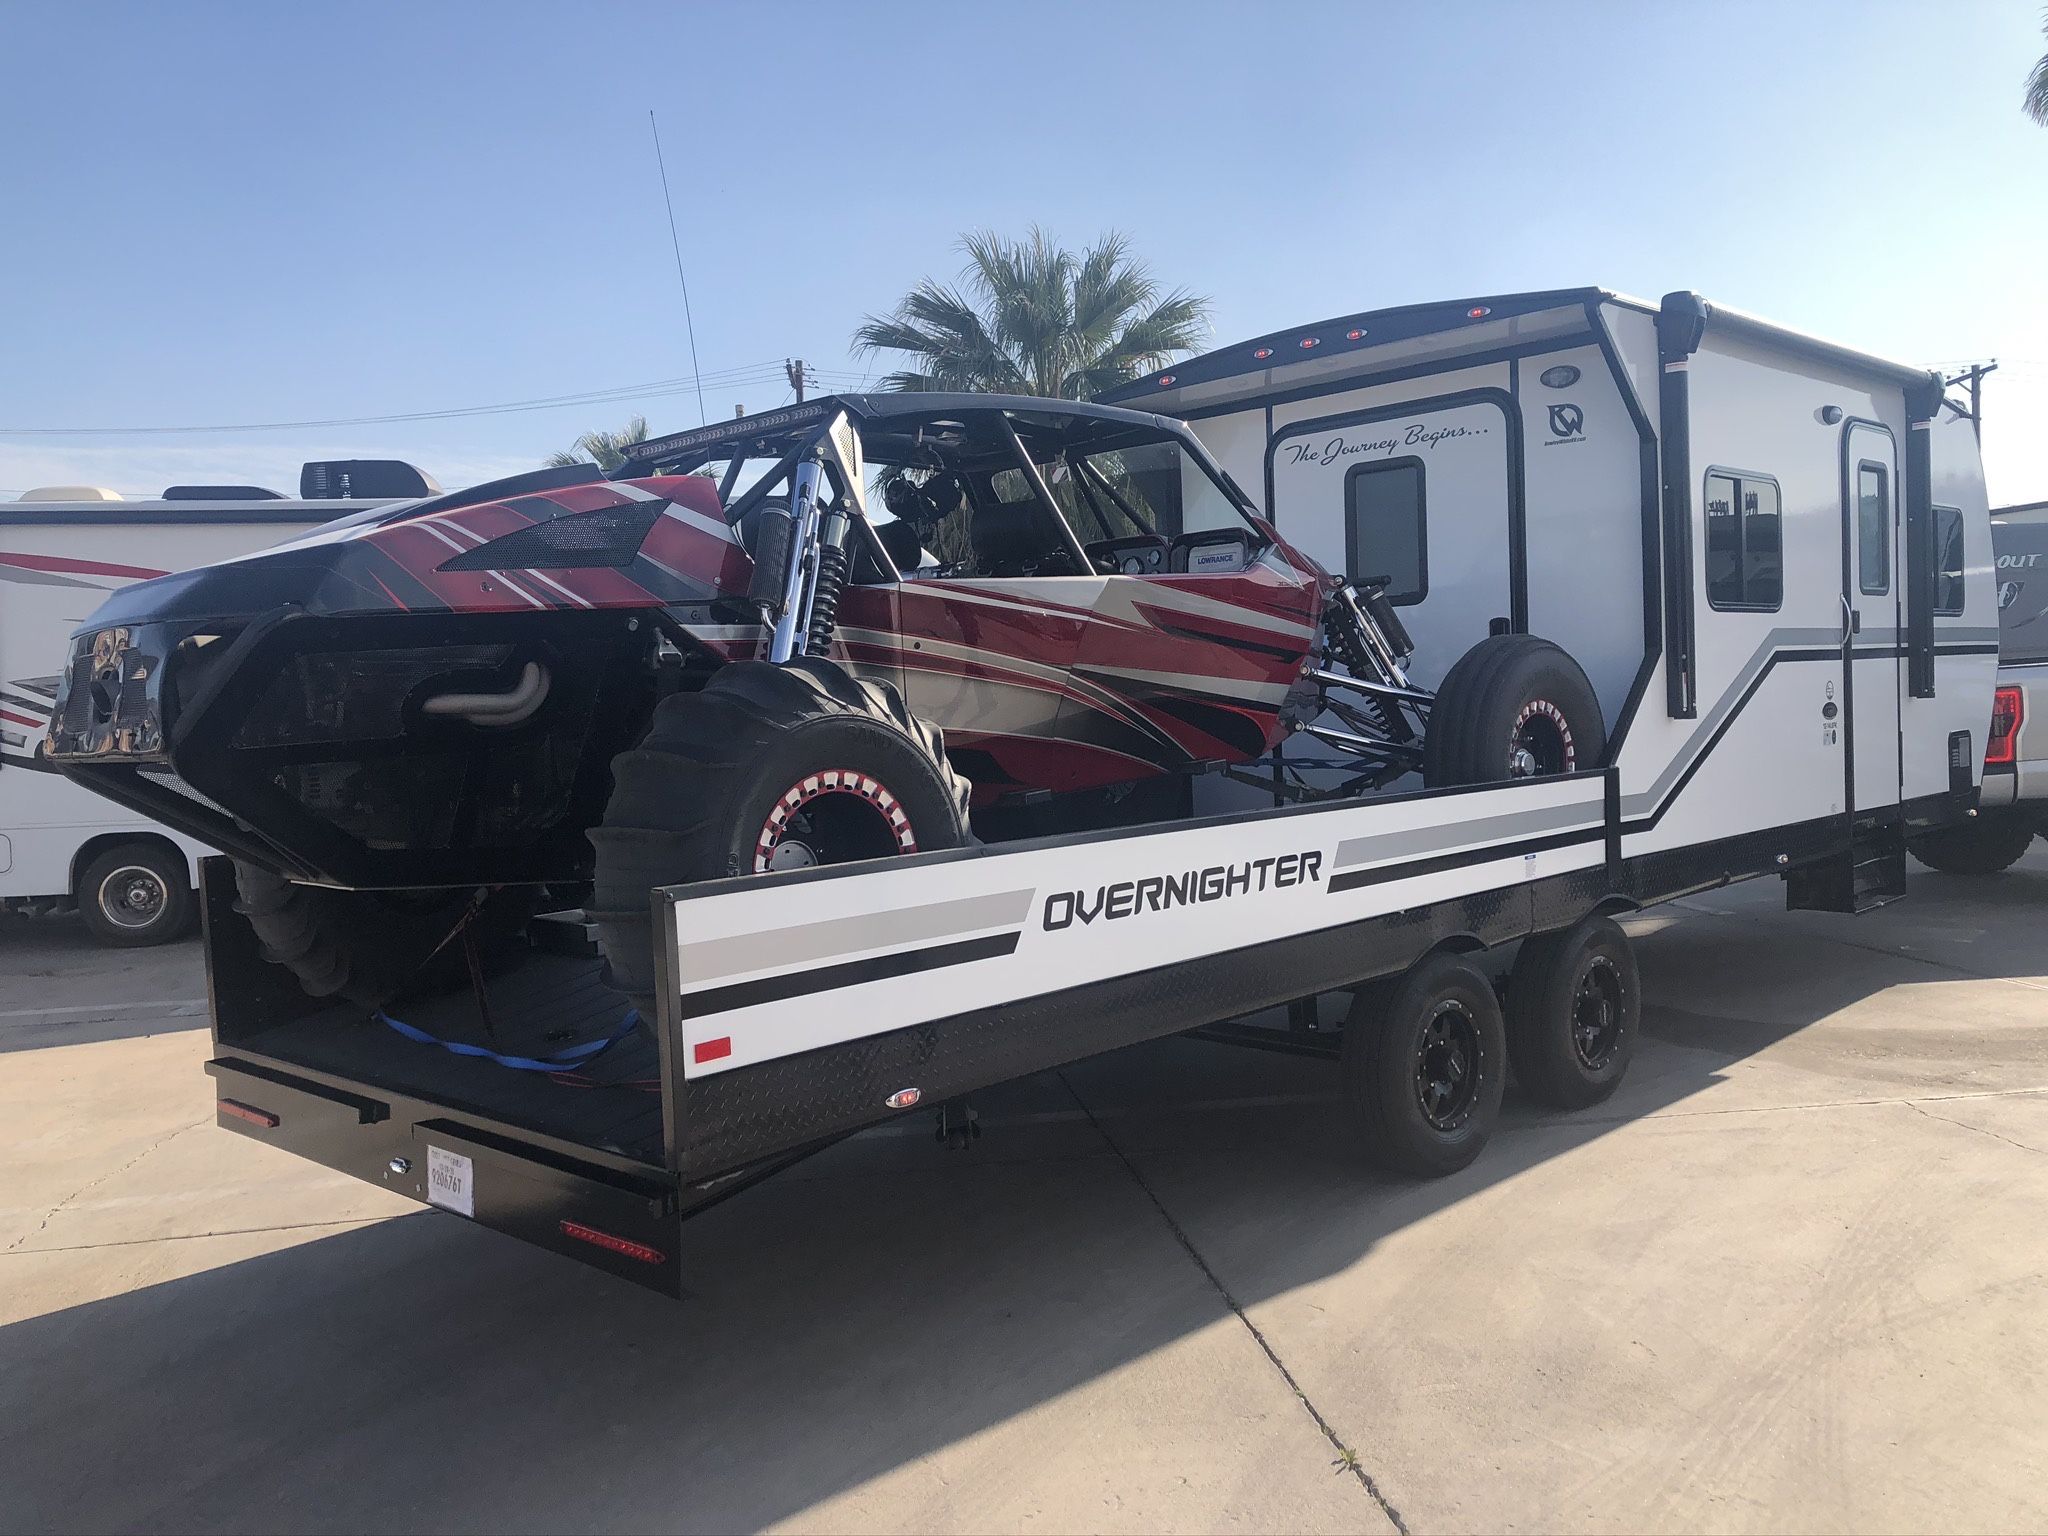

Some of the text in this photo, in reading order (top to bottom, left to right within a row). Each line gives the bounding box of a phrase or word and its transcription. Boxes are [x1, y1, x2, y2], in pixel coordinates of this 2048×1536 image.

[1284, 424, 1488, 466] The Journey Begins...
[1197, 554, 1234, 565] LOWRANCE
[1042, 850, 1322, 932] OVERNIGHTER
